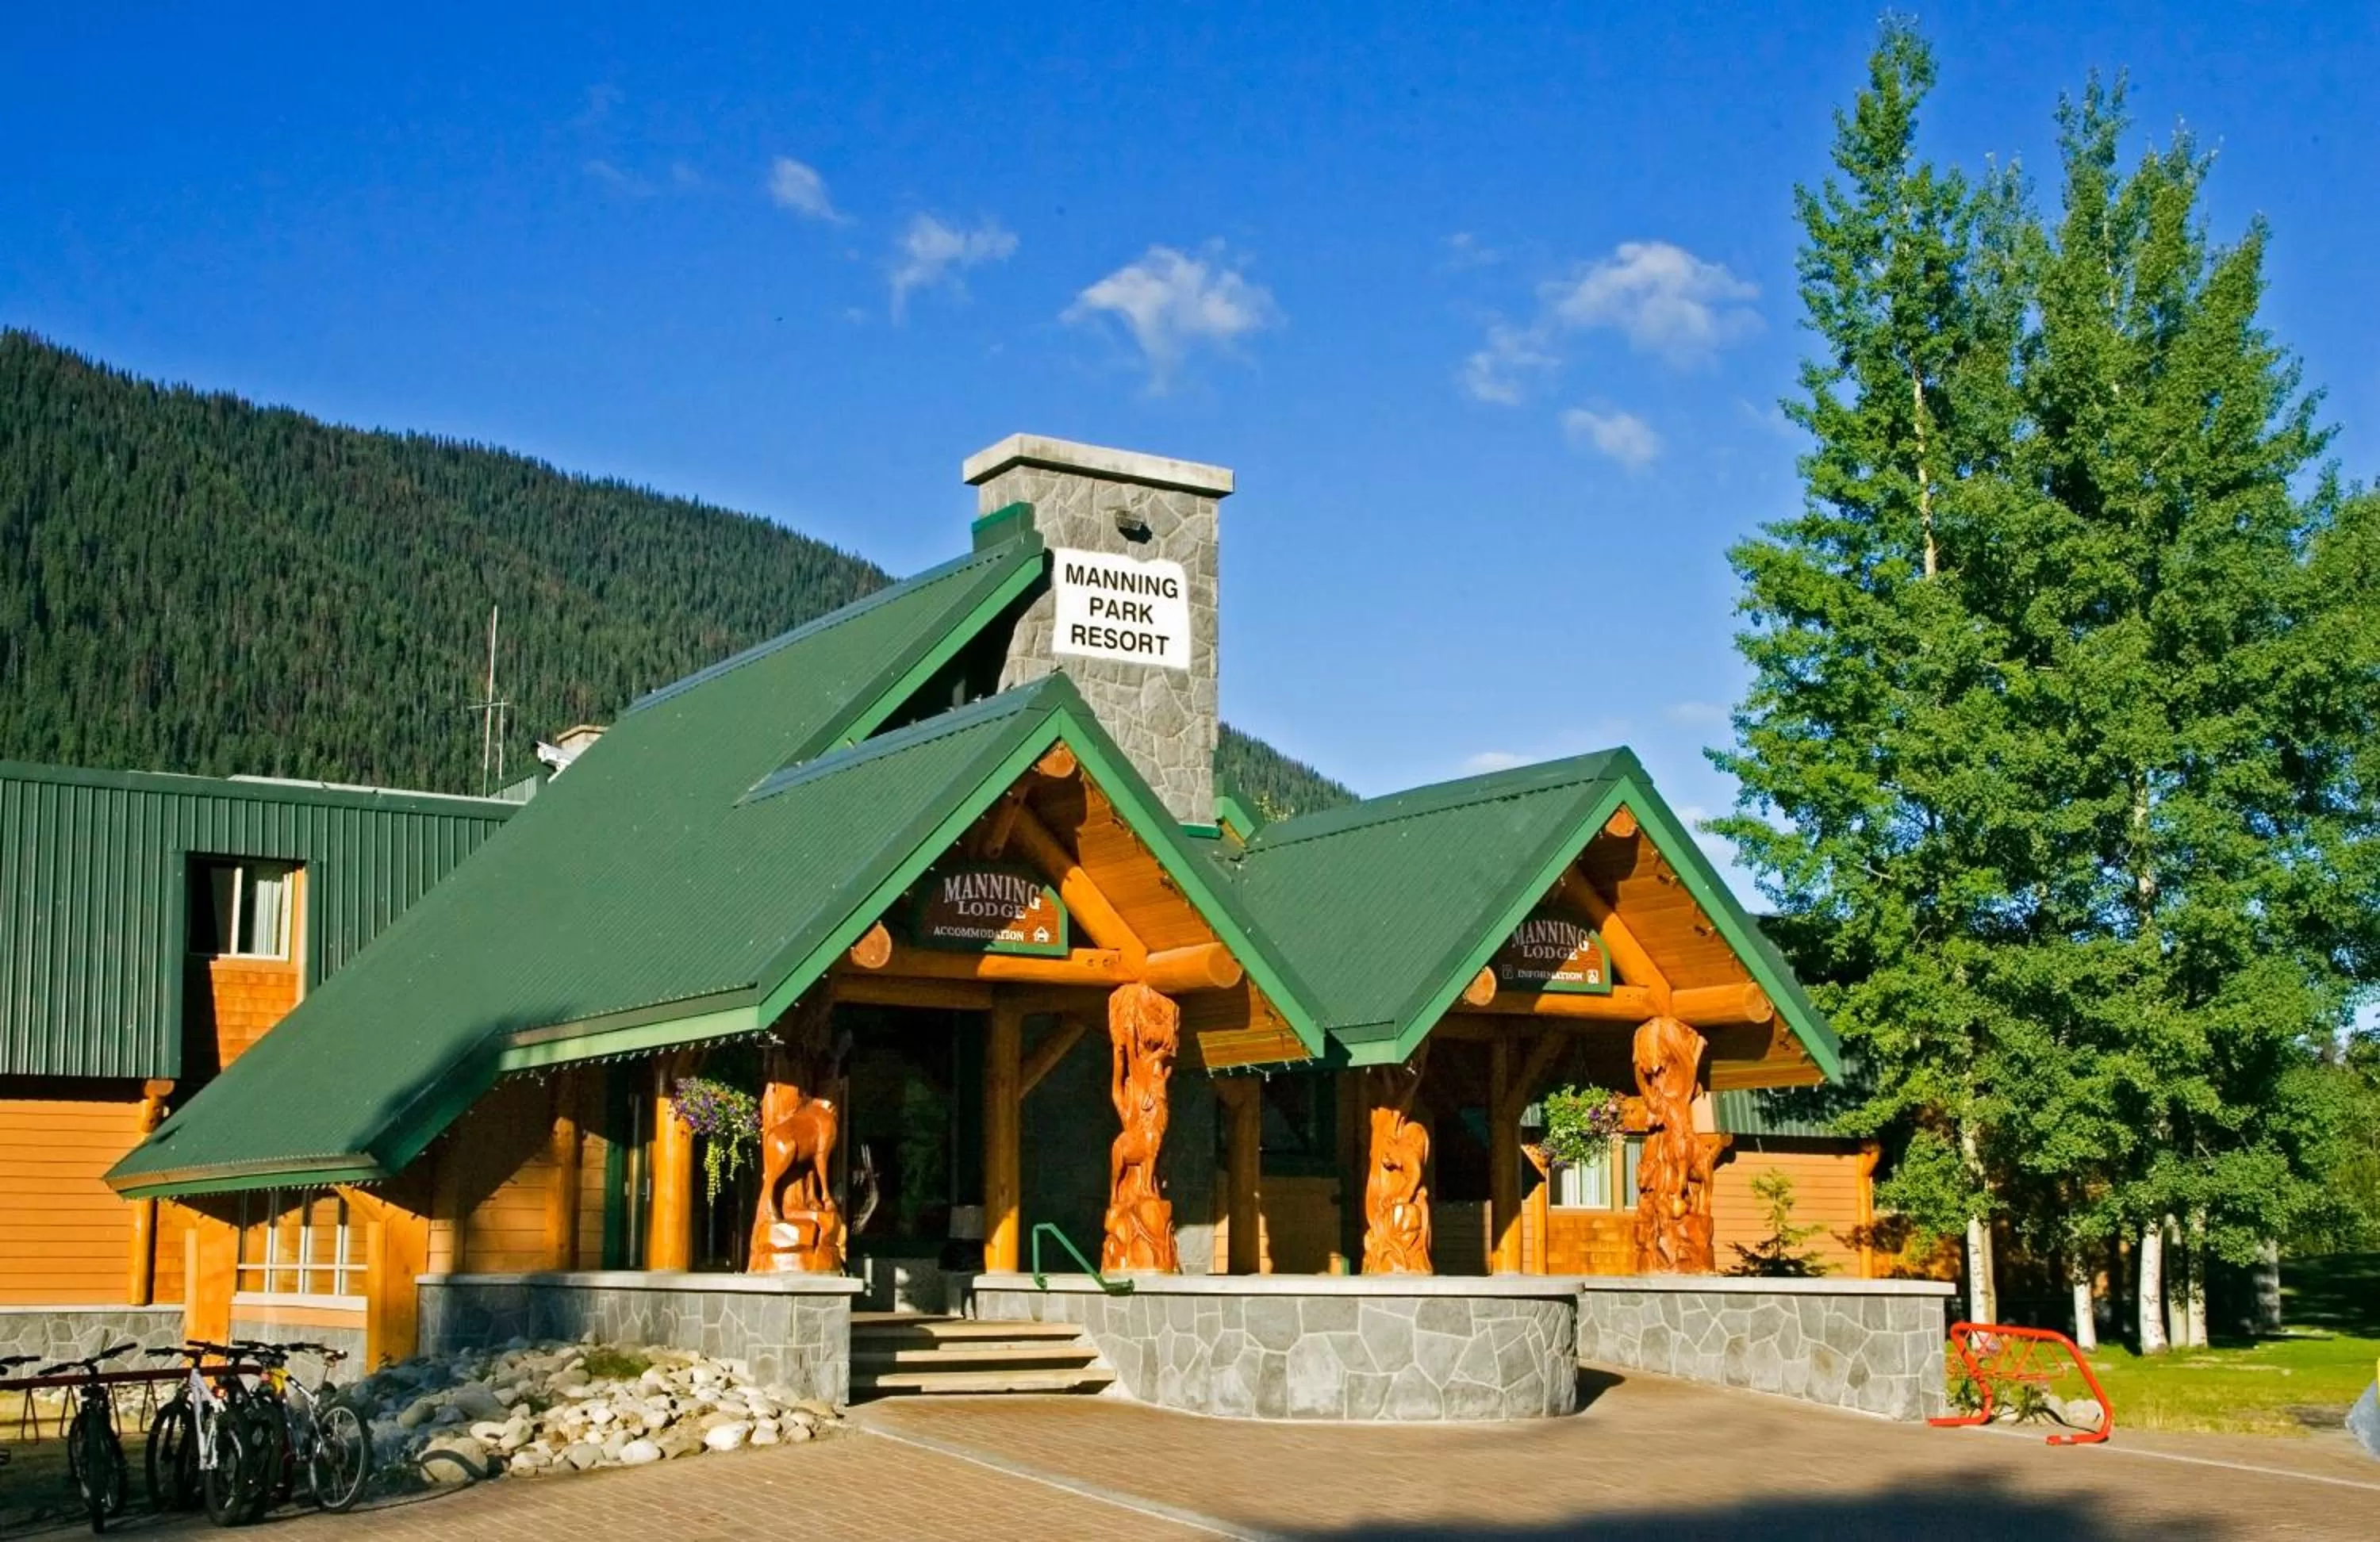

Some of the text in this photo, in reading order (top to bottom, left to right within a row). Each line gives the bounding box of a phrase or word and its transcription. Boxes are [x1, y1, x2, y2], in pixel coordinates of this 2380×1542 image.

[1065, 563, 1178, 599] MANNING
[1089, 596, 1154, 624] PARK
[1071, 623, 1169, 656] RESORT
[943, 873, 1041, 910] MANNING
[958, 900, 1026, 919] LODGE
[933, 926, 1024, 942] ACCOMMODATION
[1511, 919, 1589, 952] MANNING
[1522, 945, 1578, 961] LODGE
